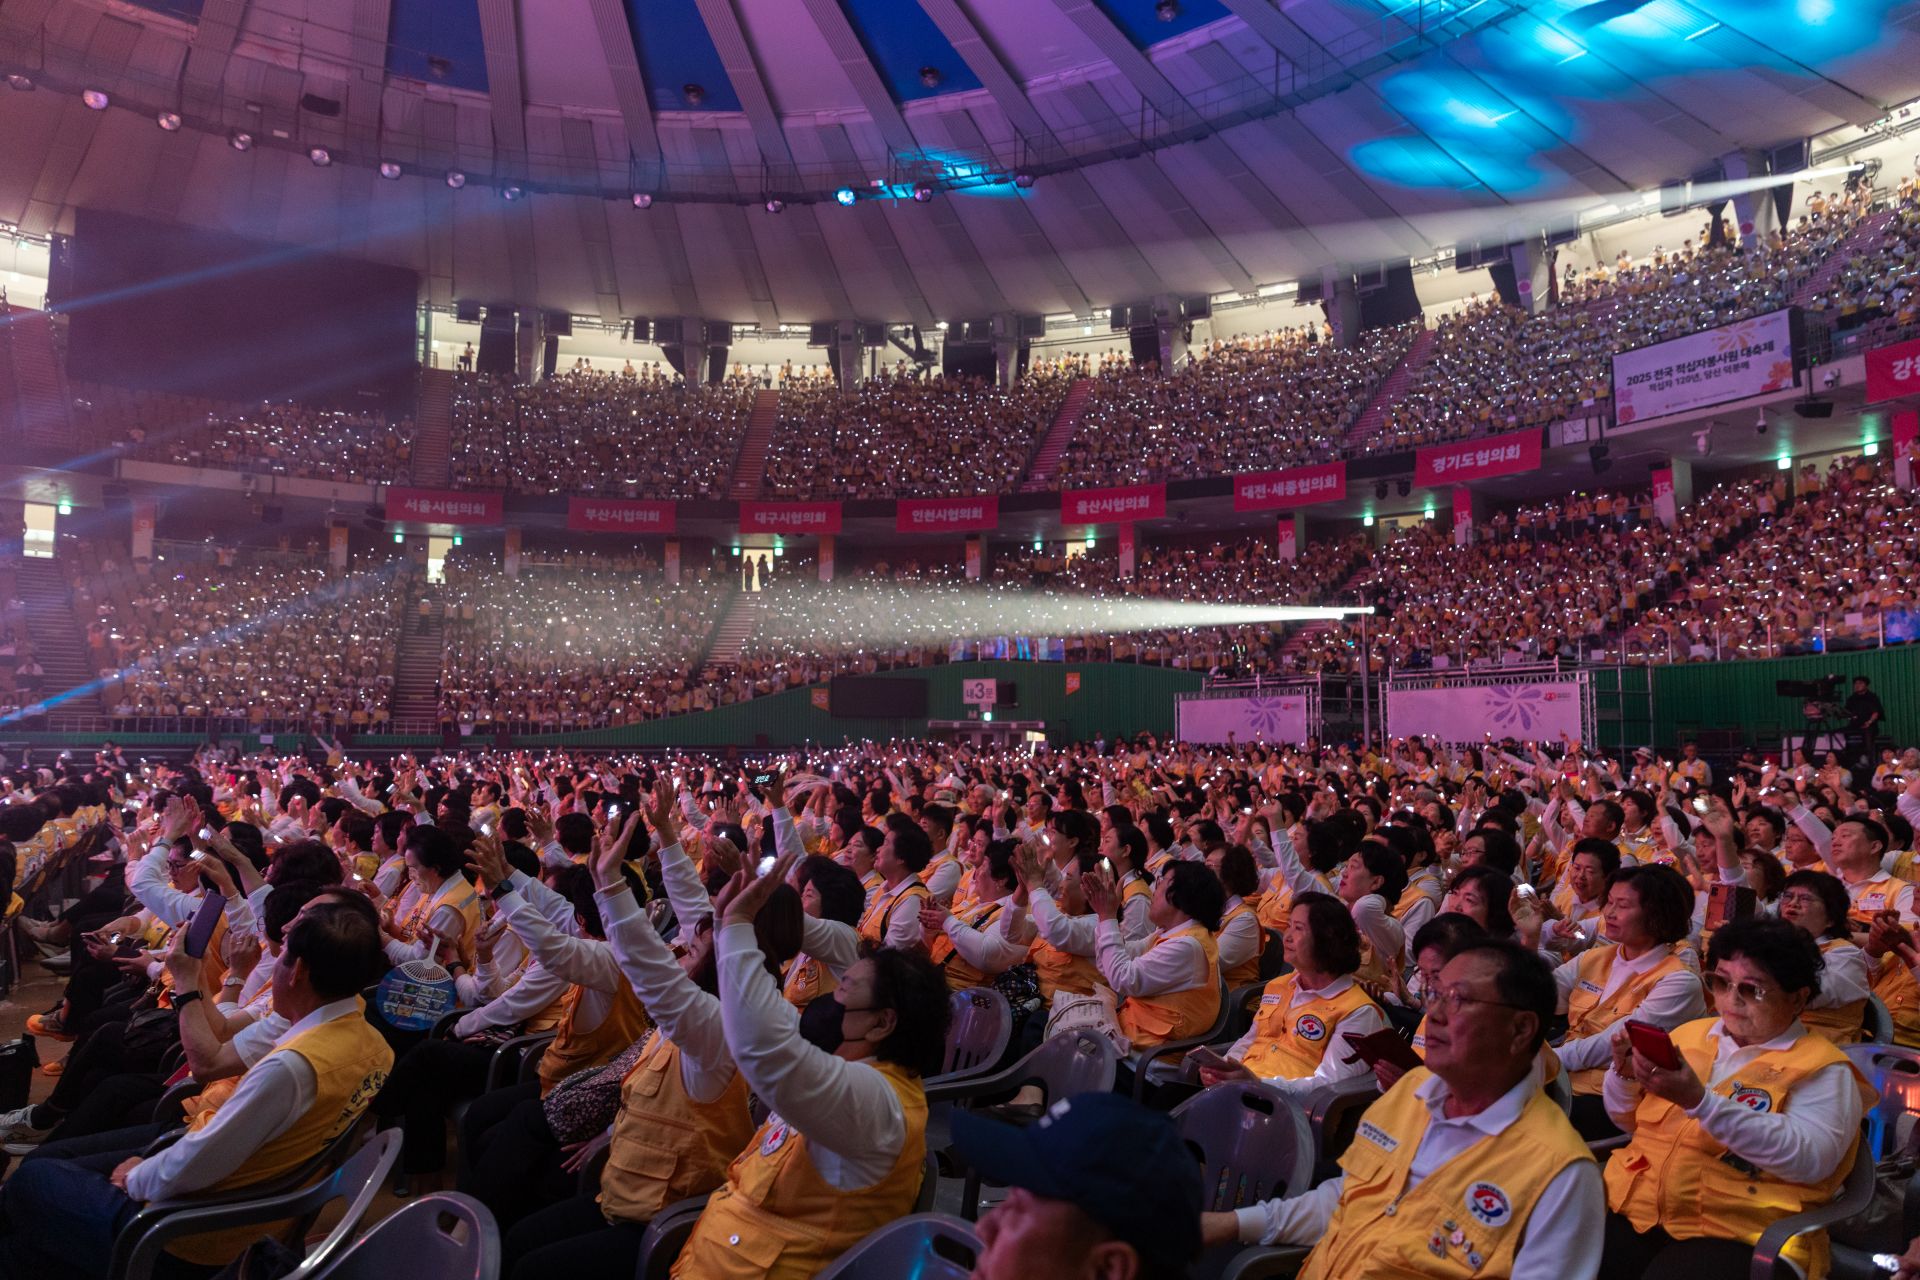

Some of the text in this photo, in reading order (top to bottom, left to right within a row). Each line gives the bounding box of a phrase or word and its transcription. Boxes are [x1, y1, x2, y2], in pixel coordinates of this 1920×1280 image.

[1626, 340, 1775, 386] 2025 전국 적십자봉사원 대축제
[1648, 379, 1673, 392] 적십자
[1703, 368, 1722, 380] 당신
[1723, 360, 1750, 376] 덕분에
[1432, 444, 1521, 473] 경기도협의회
[1241, 474, 1337, 499] 대전·세종협의회
[1655, 481, 1671, 495] 13
[404, 498, 485, 517] 서울시협의회
[1076, 496, 1150, 515] 울산시협의회
[585, 508, 660, 522] 부산시협의회
[754, 511, 827, 524] 대구시협의회
[912, 507, 982, 522] 인천시협의회
[1455, 510, 1470, 523] 13
[1280, 530, 1293, 541] 12
[1121, 542, 1132, 552] 12
